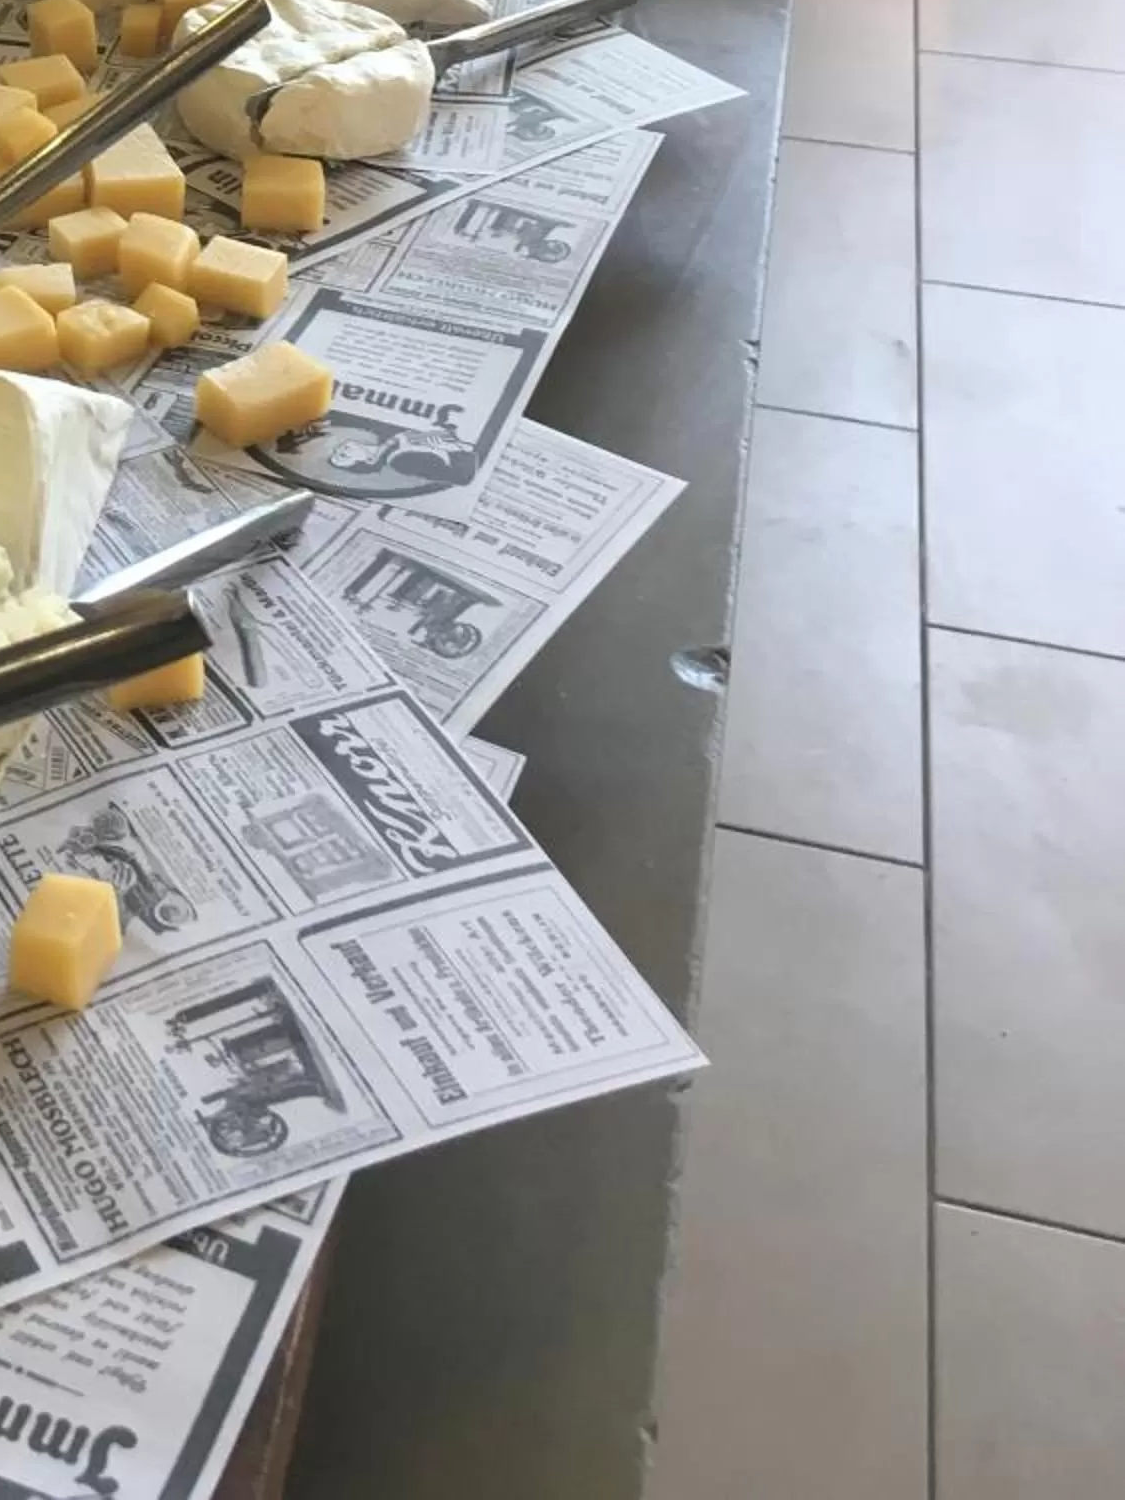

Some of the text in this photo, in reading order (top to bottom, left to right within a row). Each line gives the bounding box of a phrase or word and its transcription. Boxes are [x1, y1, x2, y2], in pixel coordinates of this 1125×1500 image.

[317, 711, 460, 874] Knorr
[327, 937, 399, 1005] Verkauf
[546, 979, 609, 1048] Theodor
[0, 1033, 87, 1159] MOSBLECH
[396, 1033, 469, 1107] Einkauf
[68, 1155, 131, 1235] HUGO
